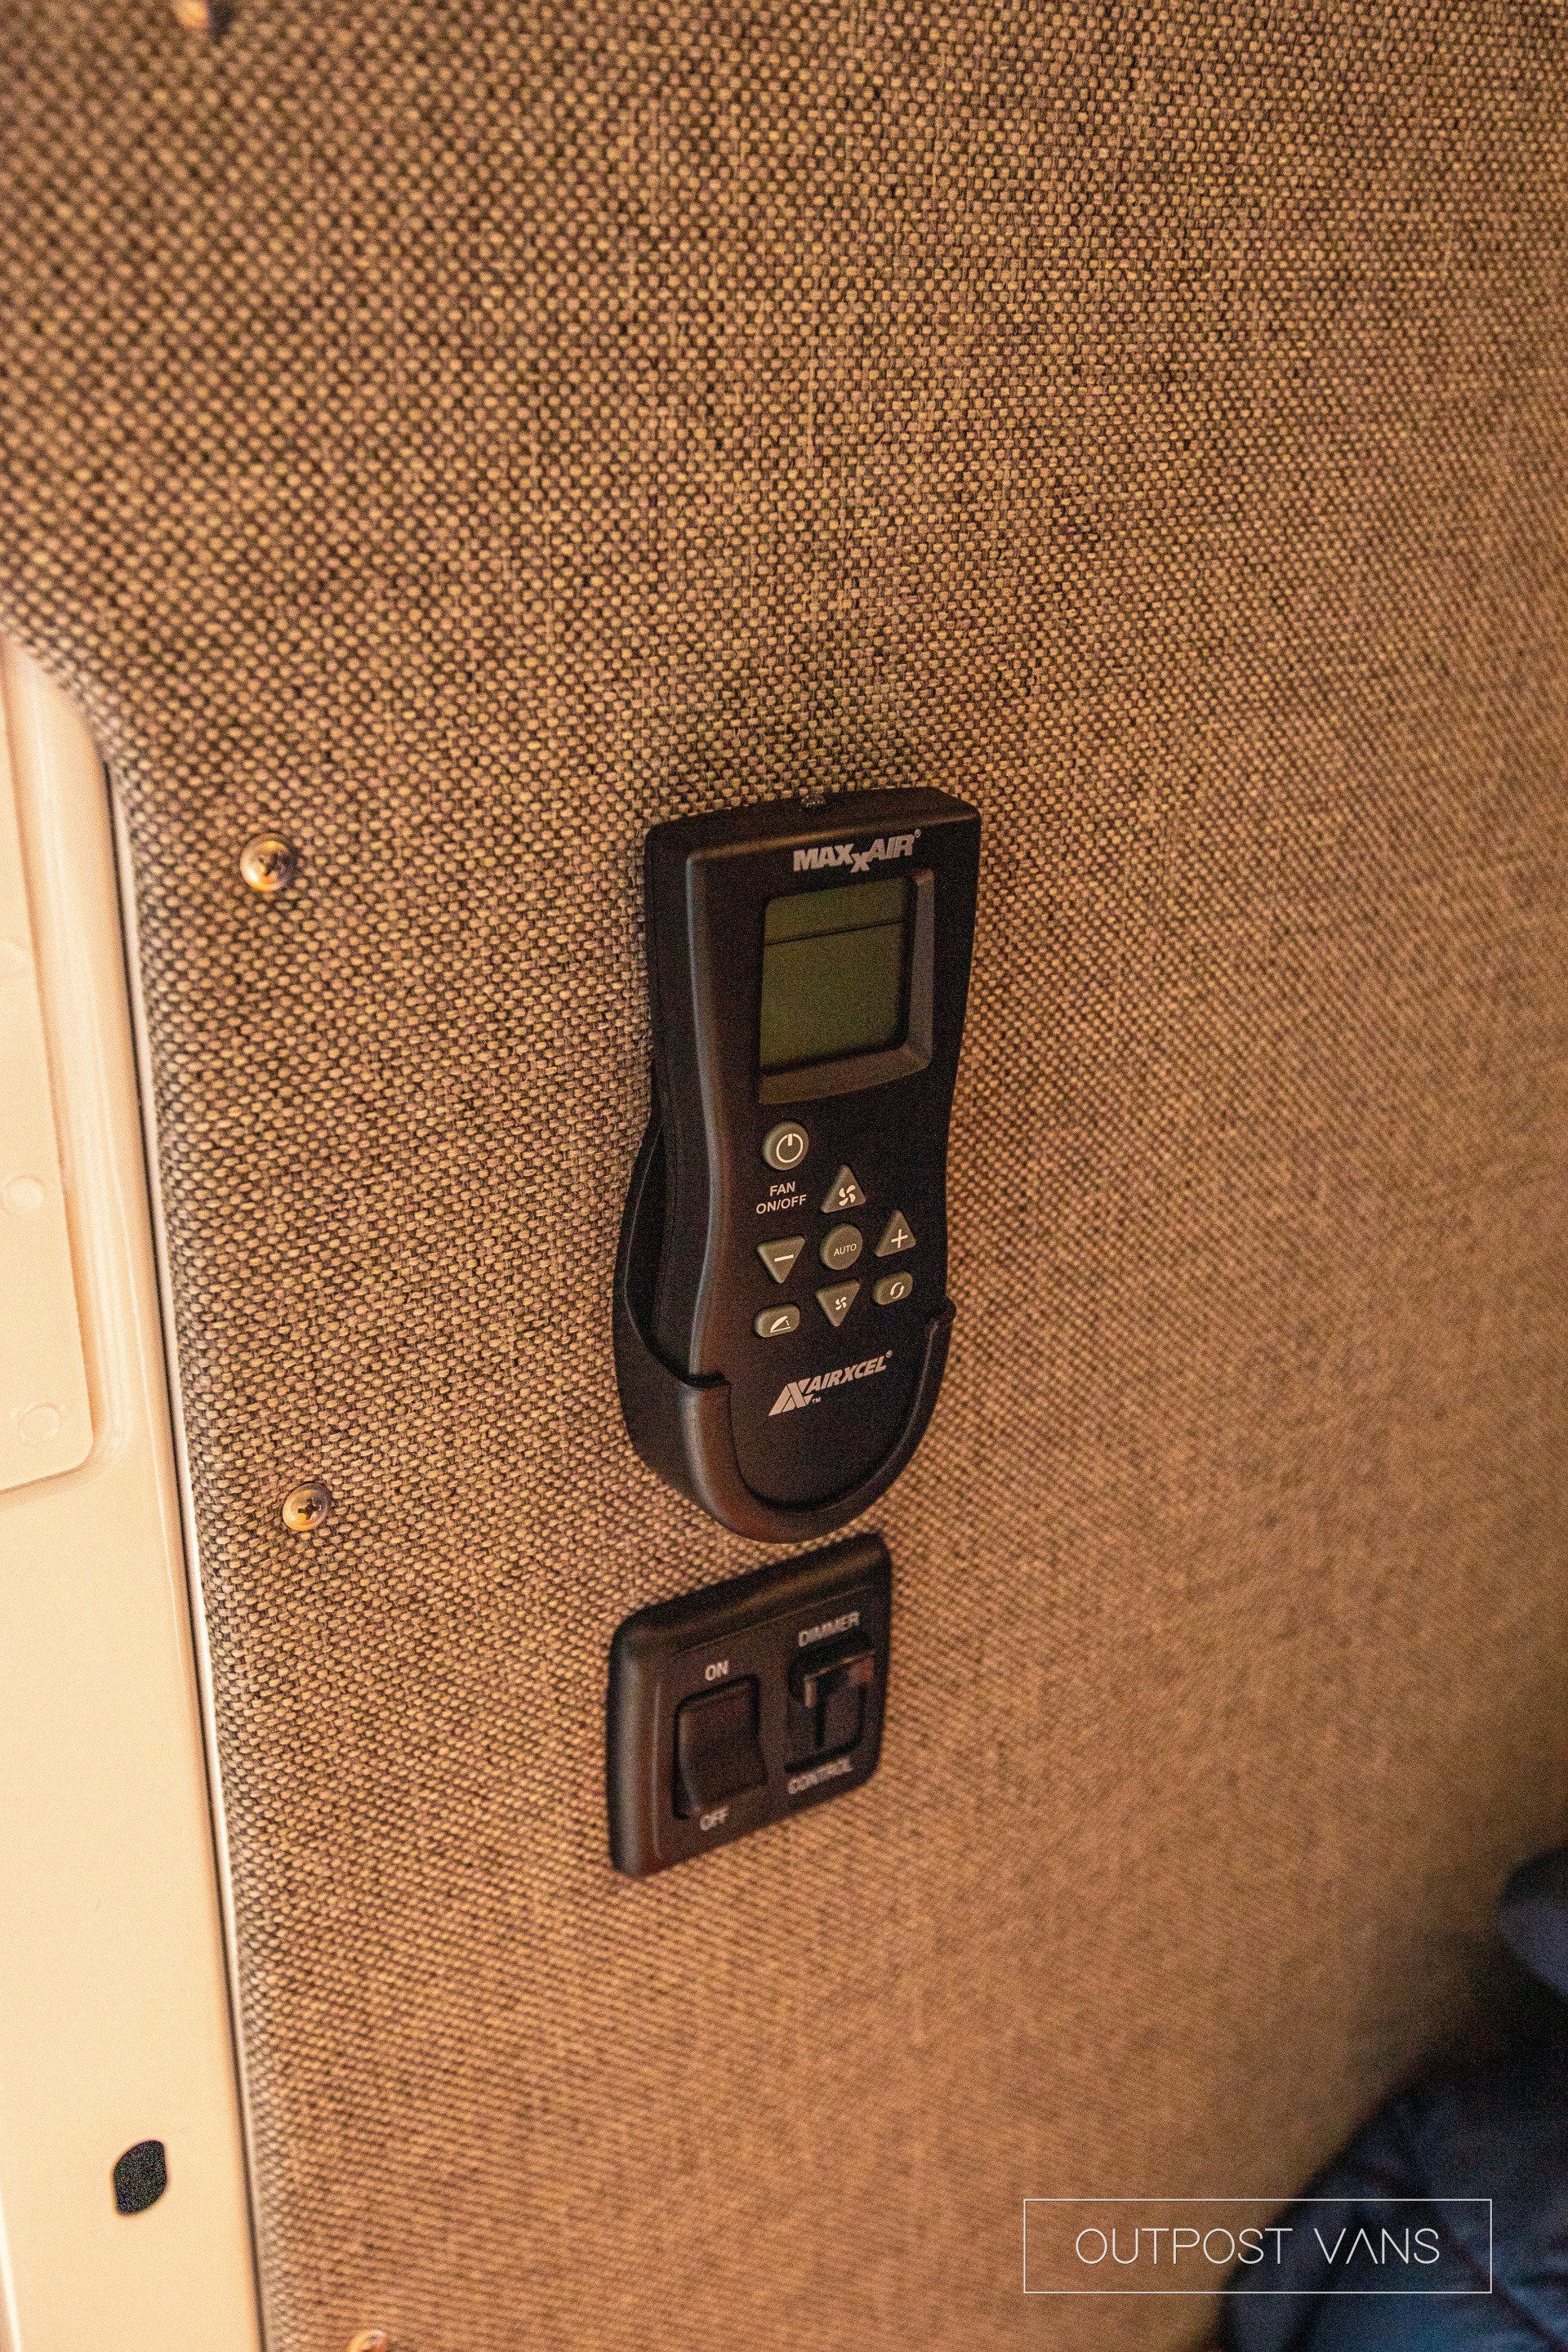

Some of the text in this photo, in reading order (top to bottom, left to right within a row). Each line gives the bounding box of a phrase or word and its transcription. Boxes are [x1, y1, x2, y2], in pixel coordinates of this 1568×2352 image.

[769, 1181, 795, 1197] FAN
[755, 1194, 807, 1214] ON/OFF
[833, 1243, 857, 1256] AUTO
[798, 1611, 860, 1647] DIMMER
[705, 1660, 729, 1681] ON
[700, 1806, 728, 1831] OFF
